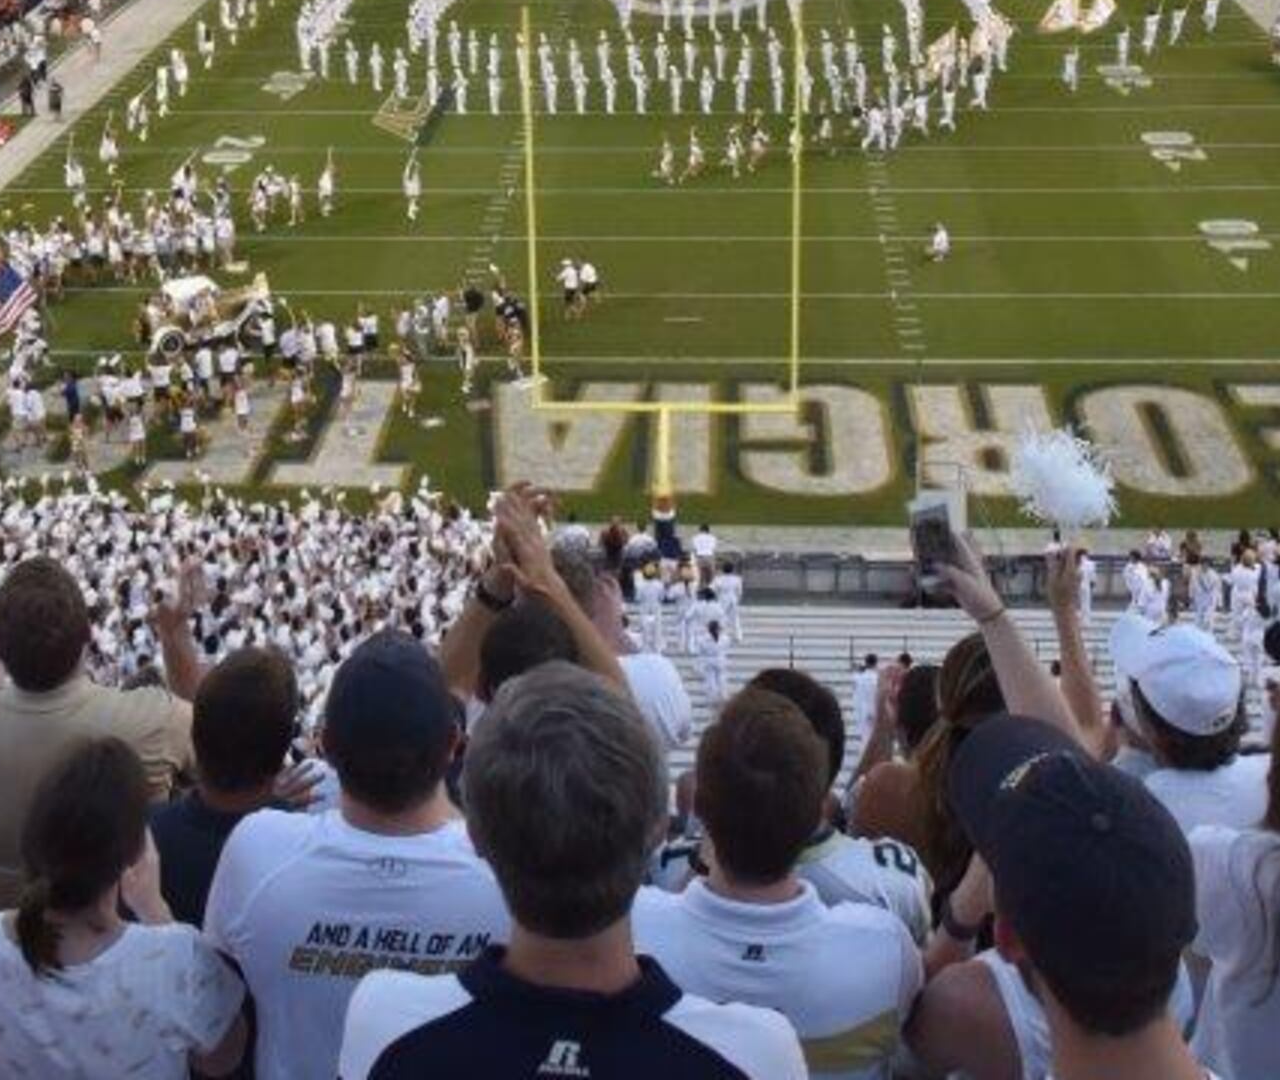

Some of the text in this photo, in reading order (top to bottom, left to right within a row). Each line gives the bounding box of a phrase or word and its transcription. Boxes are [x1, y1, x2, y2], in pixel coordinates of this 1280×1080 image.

[306, 923, 492, 957] AND A HELL OF AN
